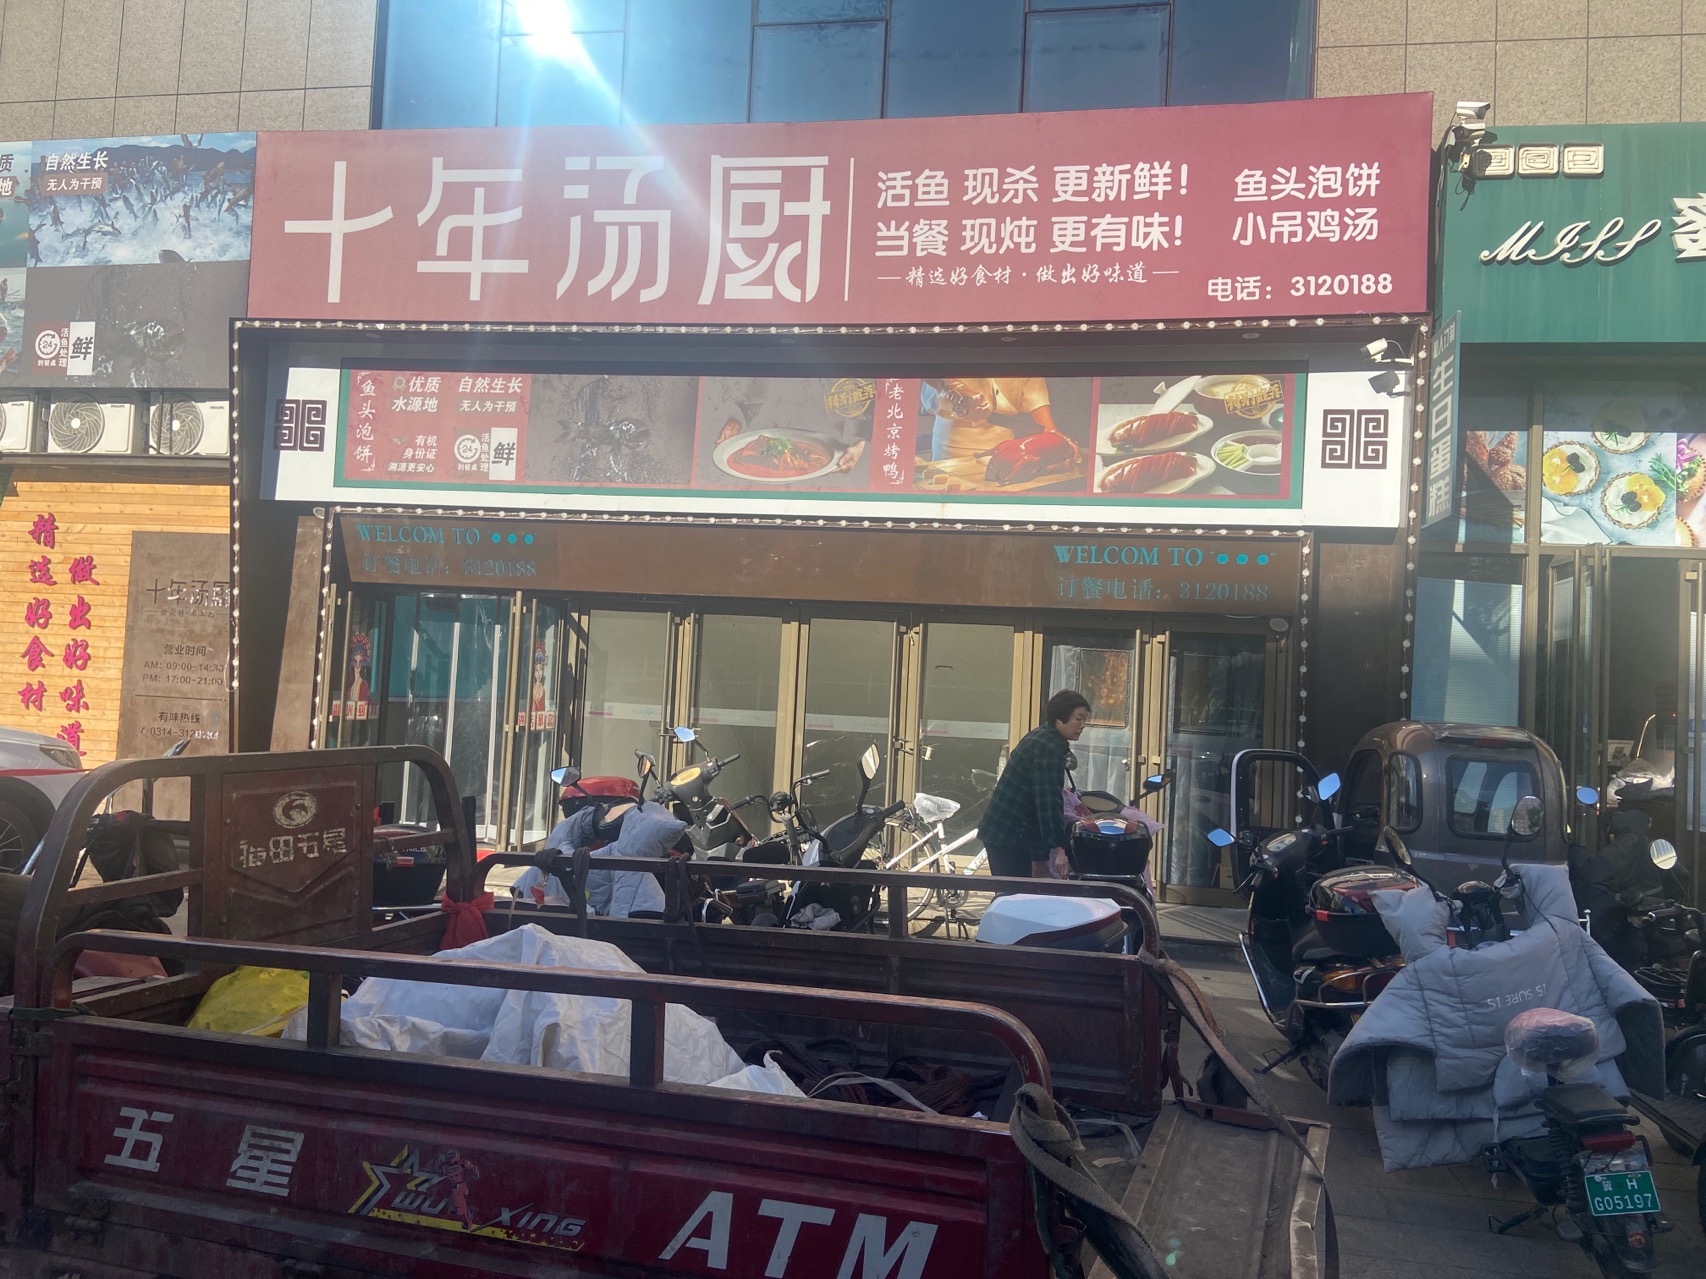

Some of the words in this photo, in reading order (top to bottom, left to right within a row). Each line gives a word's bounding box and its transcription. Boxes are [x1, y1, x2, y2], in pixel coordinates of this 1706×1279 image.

[45, 151, 109, 171] 自然生长
[46, 177, 103, 191] 无人为干预
[877, 168, 950, 208] 活鱼
[963, 164, 1040, 205] 现杀
[1052, 161, 1189, 203] 更新鲜！
[1234, 162, 1381, 202] 鱼头泡饼
[284, 154, 832, 306] 十年汤厨
[874, 217, 949, 258] 当餐
[961, 216, 1037, 255] 现炖
[1049, 212, 1184, 254] 更有味！
[1232, 207, 1379, 246] 小吊鸡汤
[1206, 275, 1273, 302] 电话：
[1289, 273, 1394, 298] 3120188
[70, 336, 93, 360] 鲜
[408, 376, 442, 393] 优质
[458, 376, 523, 393] 自然生长
[391, 396, 439, 413] 水源地
[459, 399, 518, 413] 无人为干预
[354, 379, 376, 464] 鱼头泡饼
[883, 382, 905, 480] 老北京烤鸭
[415, 434, 438, 447] 有机
[1428, 354, 1455, 518] 生日蛋糕
[402, 447, 438, 460] 身份证
[491, 441, 516, 466] 鲜
[356, 523, 445, 545] WELCOM
[451, 527, 481, 545] TO
[1053, 545, 1160, 566] WELCOM
[1167, 546, 1204, 567] TO
[463, 559, 537, 577] 3120188
[1179, 581, 1269, 601] 3120188
[18, 512, 58, 713] 精选好食材
[163, 644, 207, 657] 营业时间
[158, 711, 201, 724] 有味热线
[104, 1106, 304, 1198] 五星
[1594, 1193, 1652, 1211] G05197
[658, 1190, 940, 1279] ATM
